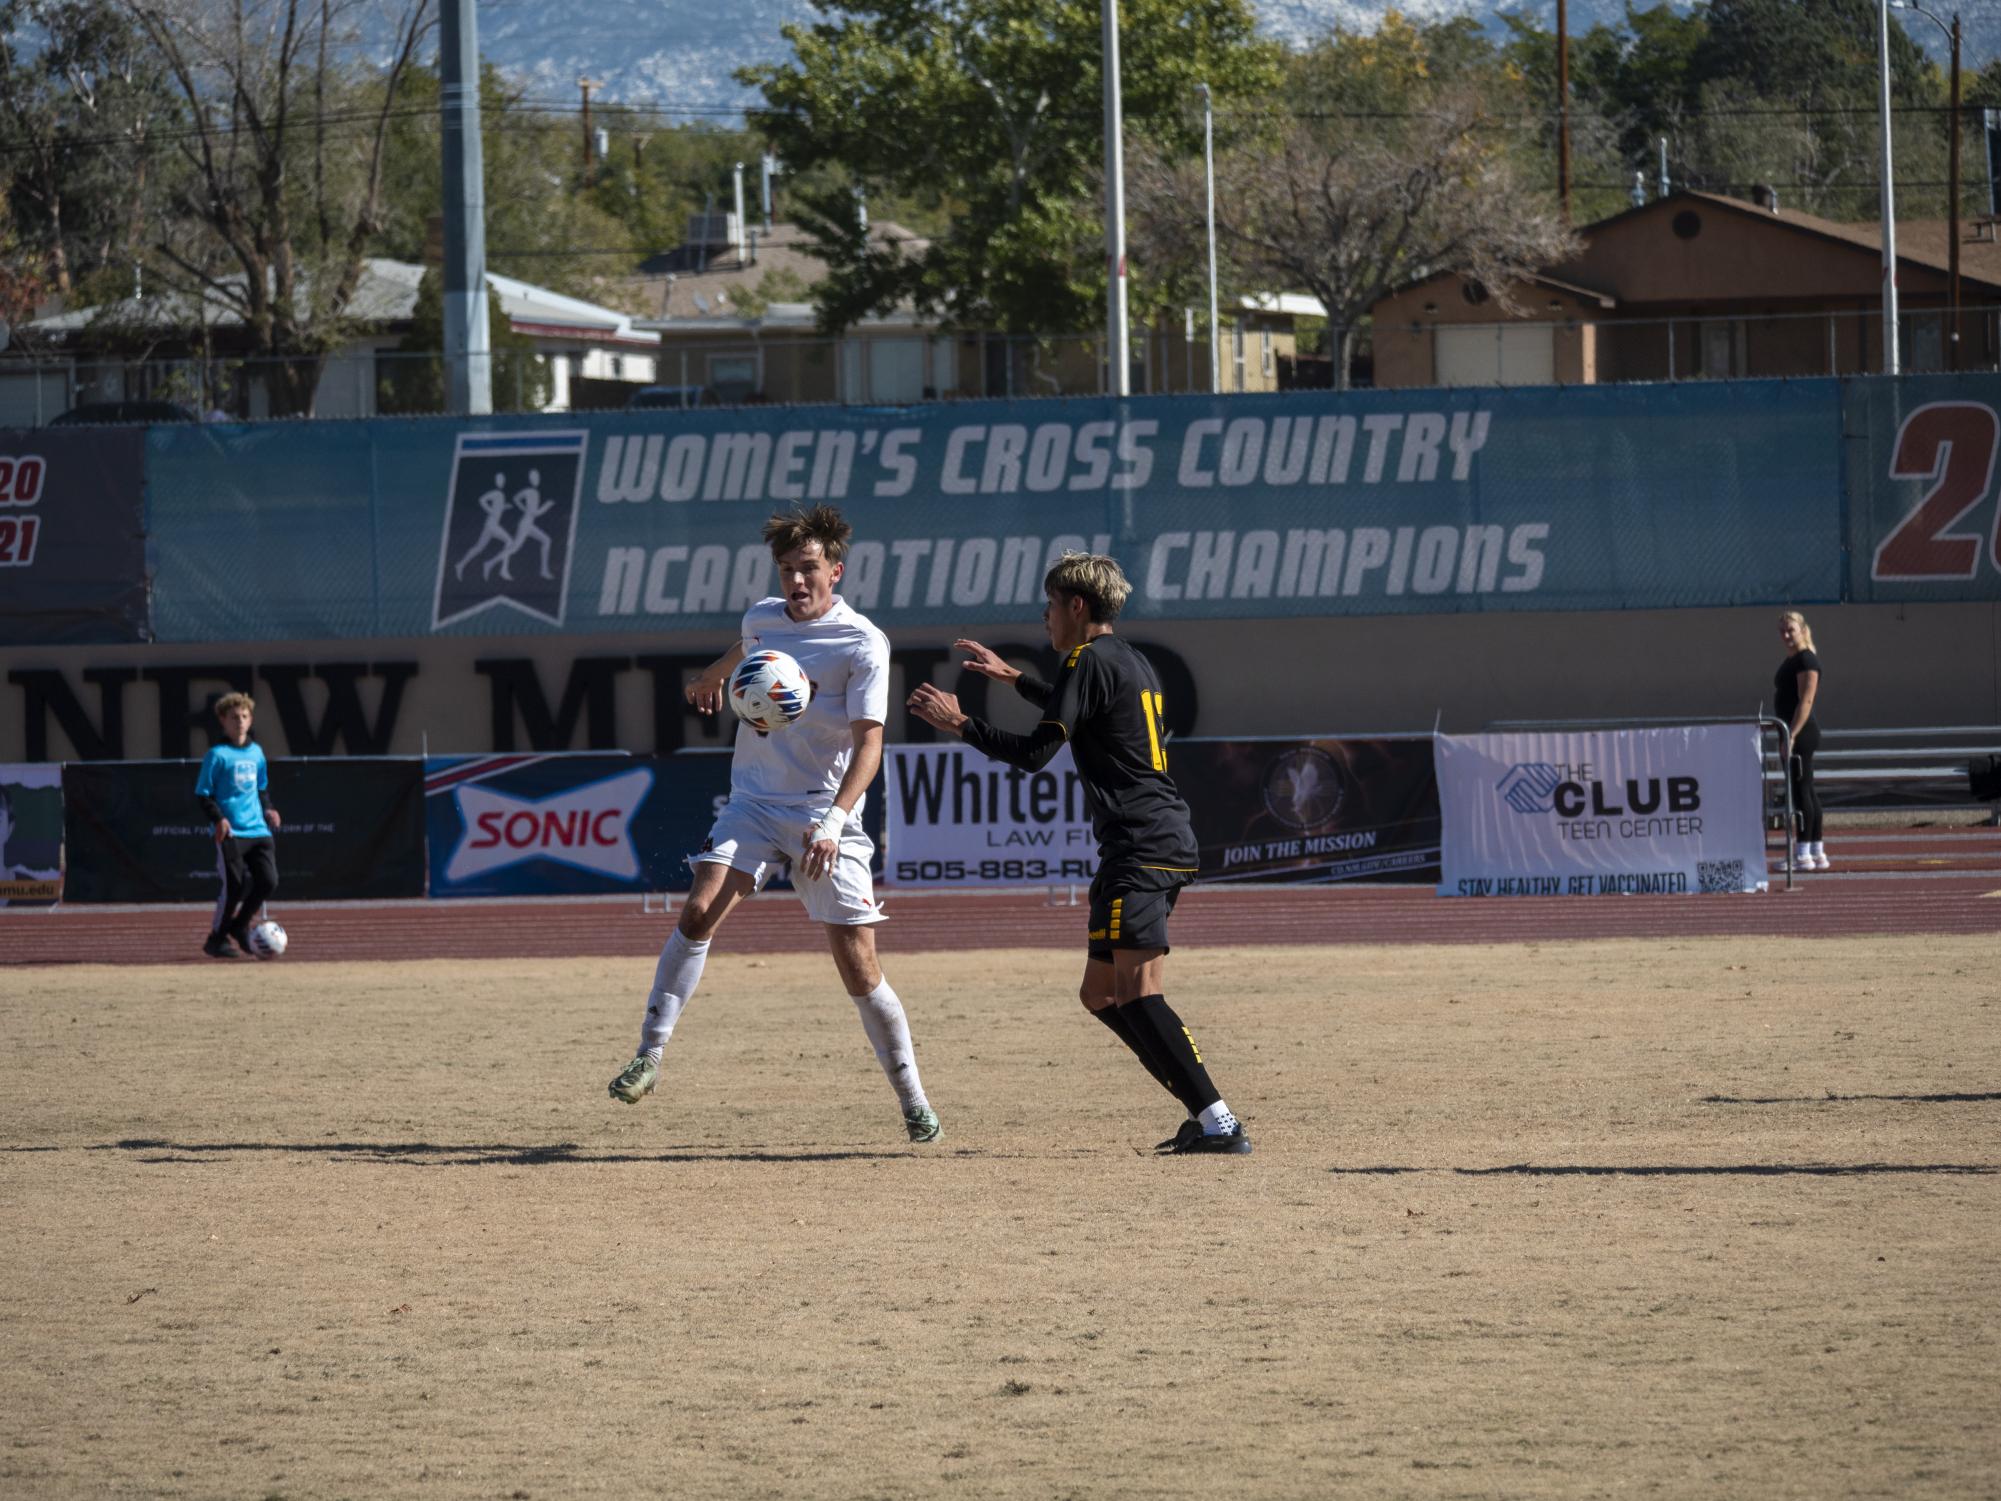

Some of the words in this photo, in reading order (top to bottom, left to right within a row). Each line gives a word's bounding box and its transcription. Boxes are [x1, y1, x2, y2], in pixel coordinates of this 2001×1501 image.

[597, 428, 922, 503] WOMEN'S
[940, 420, 1159, 494] CROSS
[1177, 410, 1491, 487] COUNTRY
[1871, 401, 2001, 581] 2
[1145, 523, 1549, 600] CHAMPIONS
[895, 752, 1092, 826] Whiten
[1554, 763, 1594, 781] THE
[1553, 776, 1701, 818] CLUB
[469, 808, 622, 849] SONIC
[987, 830, 1054, 847] LAW
[1066, 829, 1093, 846] FI
[1557, 821, 1611, 840] TEEN
[1620, 816, 1704, 839] CENTER
[1222, 845, 1262, 868] JOIN
[1265, 840, 1301, 858] THE
[1304, 831, 1377, 854] MISSION
[1457, 877, 1493, 896] STAY
[1568, 875, 1594, 895] GET
[1599, 871, 1687, 894] VACCINATED
